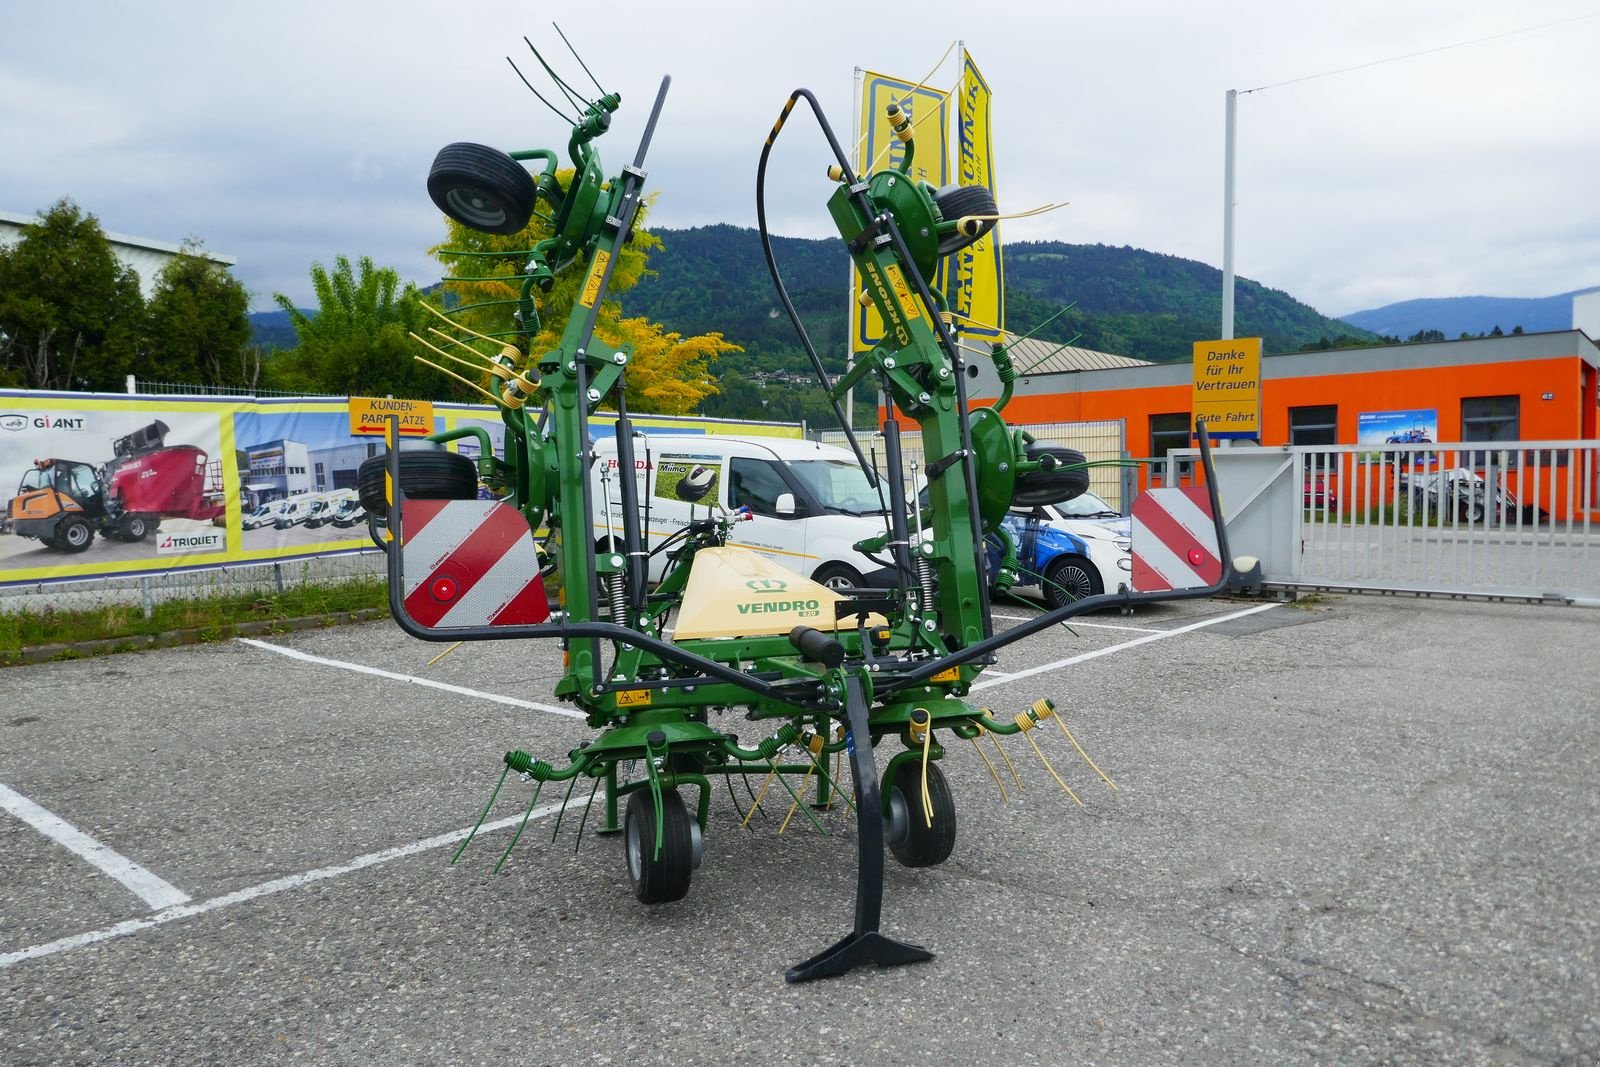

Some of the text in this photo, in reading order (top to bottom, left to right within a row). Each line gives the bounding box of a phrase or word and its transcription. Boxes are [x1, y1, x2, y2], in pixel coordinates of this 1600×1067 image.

[865, 262, 900, 325] KRONE
[1207, 349, 1245, 361] Danke
[1206, 364, 1244, 376] für Ihr
[1196, 380, 1256, 391] Vertrauen
[370, 400, 417, 411] KUNDEN-
[1195, 412, 1255, 422] Gute Fahrt
[172, 535, 219, 547] TRIOLIET
[737, 599, 819, 615] VENDRO
